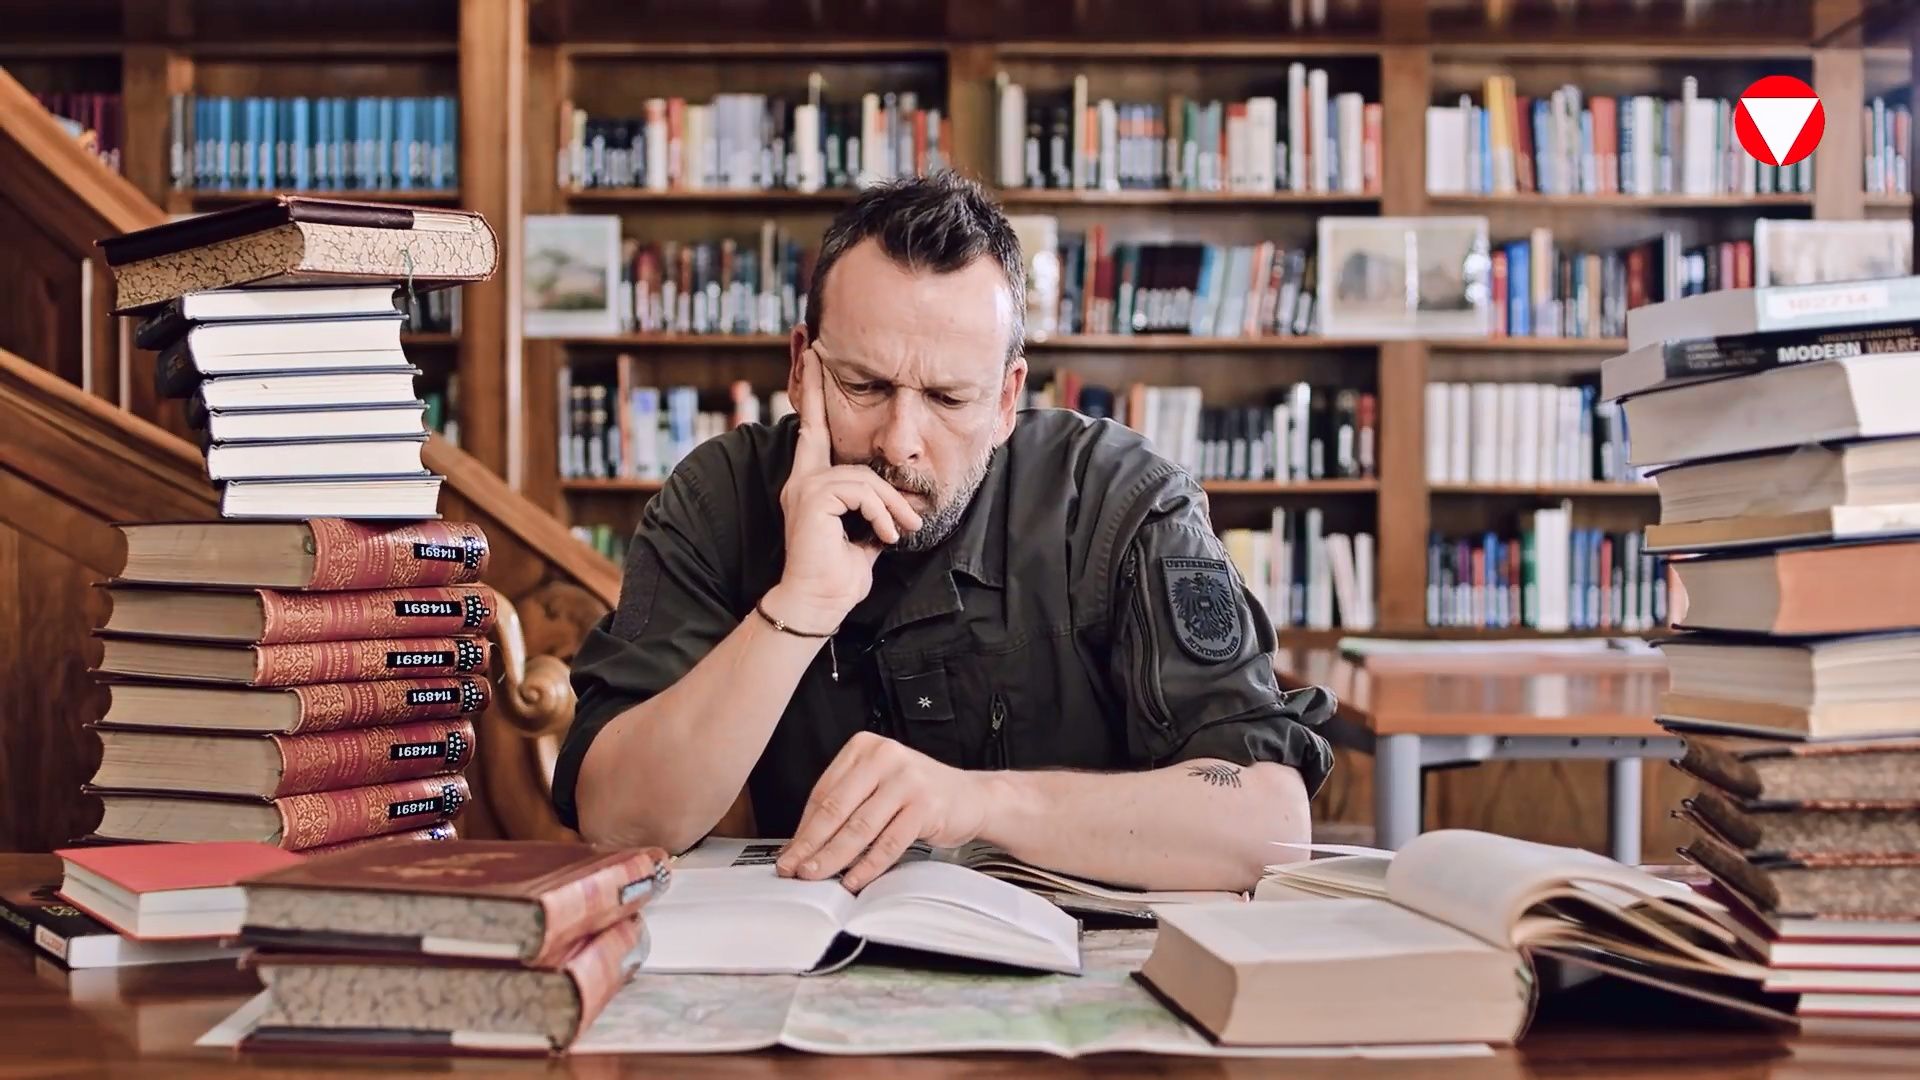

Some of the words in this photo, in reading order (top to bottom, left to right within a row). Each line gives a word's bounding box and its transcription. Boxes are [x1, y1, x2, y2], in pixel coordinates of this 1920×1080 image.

[1818, 327, 1914, 343] UNDERSTANDING
[1777, 341, 1862, 363] MODERN
[1866, 336, 1920, 354] WARF
[421, 546, 457, 558] 114891
[404, 602, 452, 614] 114891
[396, 653, 444, 666] 114891
[412, 690, 452, 703] 114891
[398, 744, 438, 758] 114891
[396, 800, 434, 815] 114891
